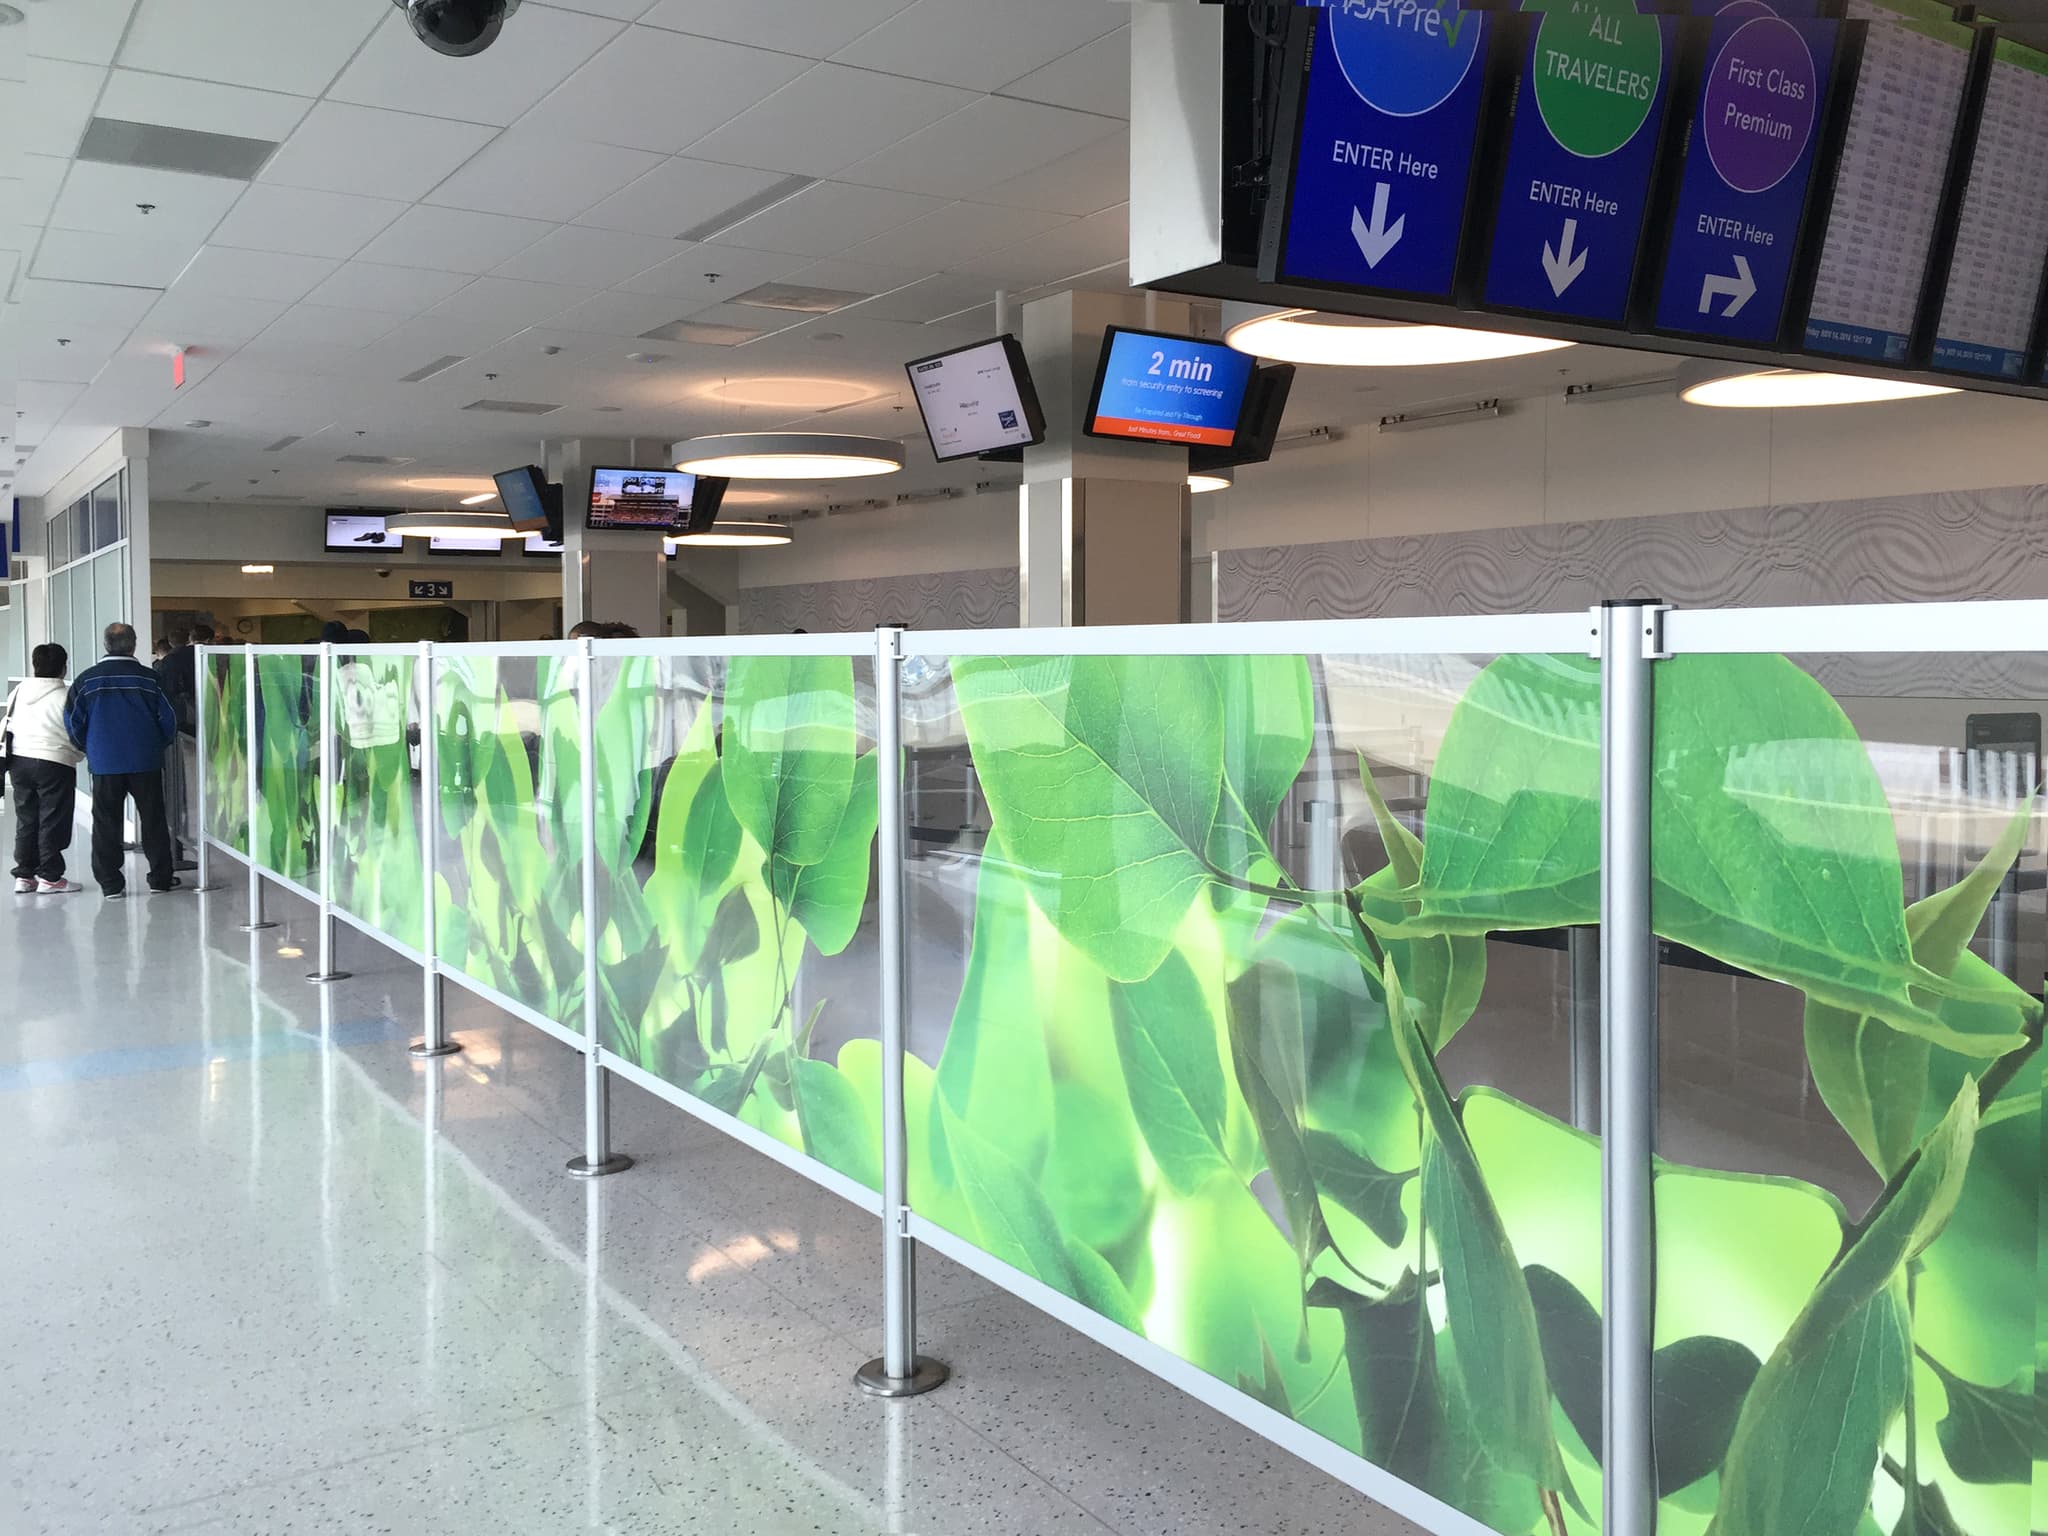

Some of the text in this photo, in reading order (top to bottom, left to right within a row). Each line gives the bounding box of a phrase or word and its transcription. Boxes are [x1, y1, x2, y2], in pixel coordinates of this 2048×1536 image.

[1589, 14, 1623, 46] ALL
[1546, 50, 1651, 100] TRAVELERS
[1728, 57, 1806, 100] First Class
[1724, 103, 1793, 141] Premium
[1333, 140, 1439, 180] ENTER Here
[1529, 180, 1618, 216] ENTER Here
[1697, 214, 1774, 246] ENTER Here
[1148, 351, 1213, 382] 2 min
[1139, 380, 1165, 392] security
[1166, 382, 1184, 394] entry
[1184, 385, 1193, 394] to
[1193, 387, 1224, 399] screening
[427, 583, 436, 597] 3
